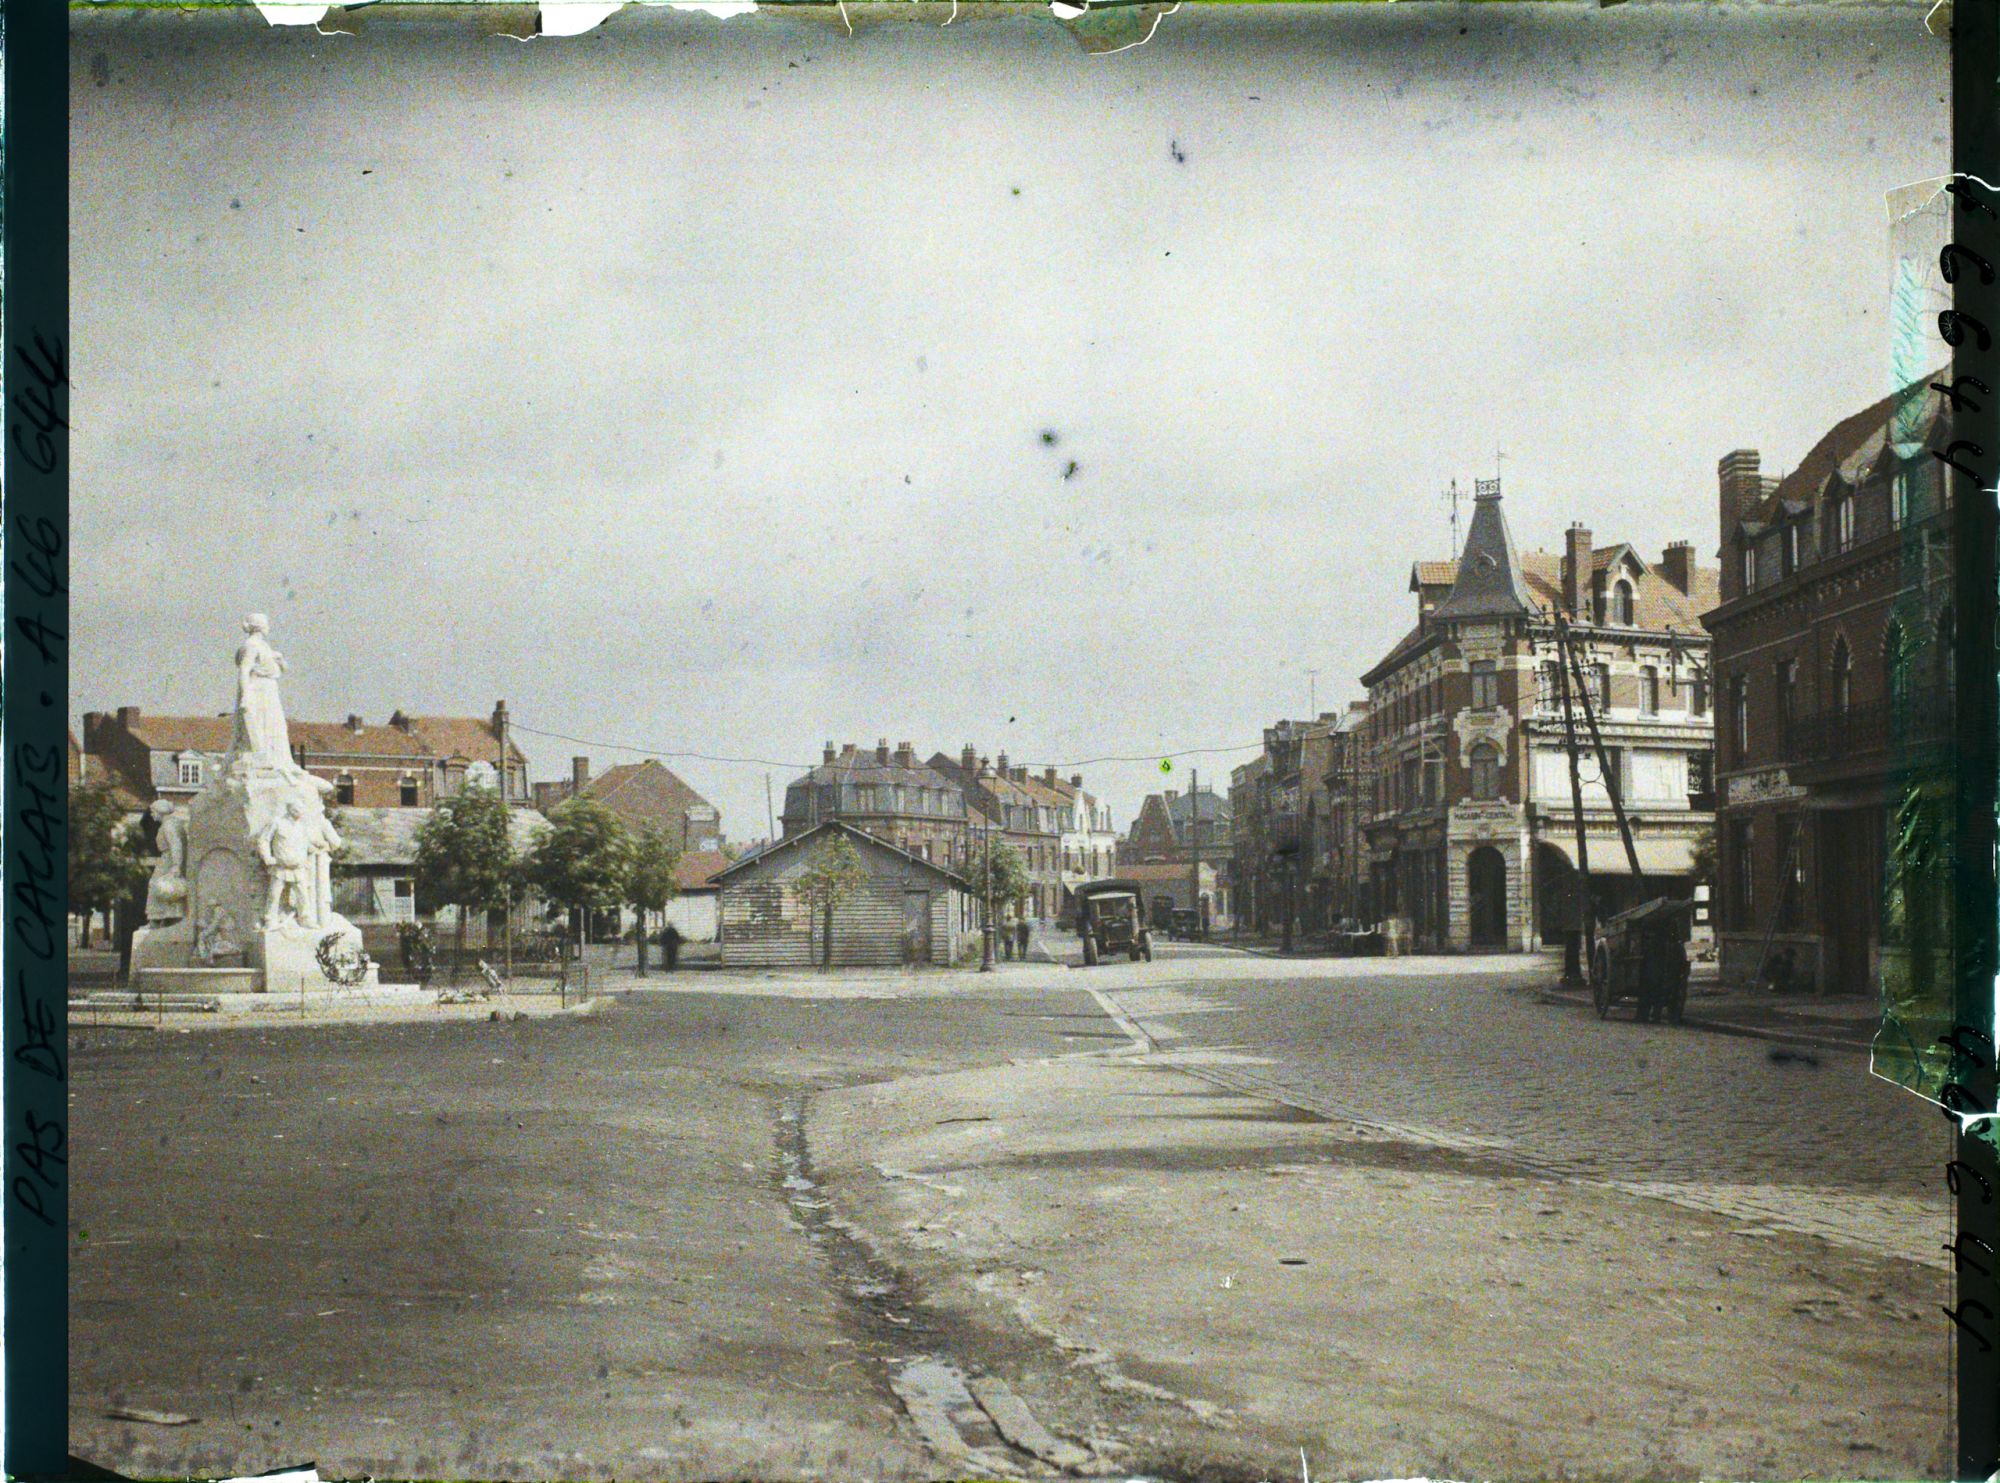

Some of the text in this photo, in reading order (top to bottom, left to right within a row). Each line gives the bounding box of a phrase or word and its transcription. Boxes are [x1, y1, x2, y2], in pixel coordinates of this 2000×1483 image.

[12, 326, 69, 474] 644
[13, 743, 60, 960] CALAIS
[14, 969, 61, 1082] DE
[13, 1109, 66, 1227] PAS
